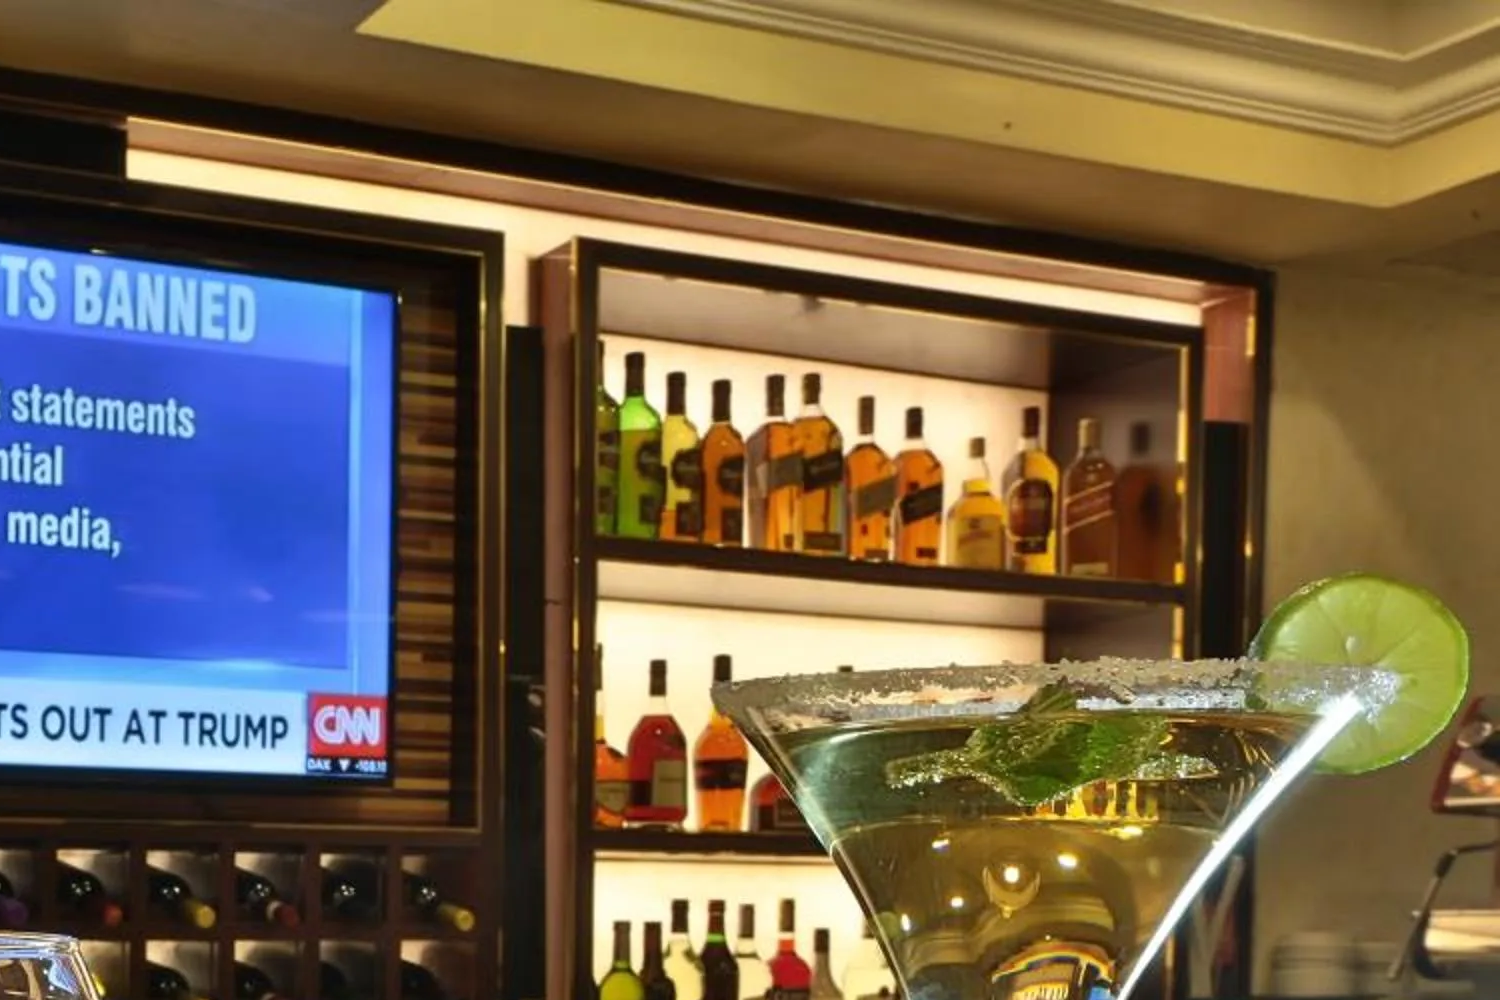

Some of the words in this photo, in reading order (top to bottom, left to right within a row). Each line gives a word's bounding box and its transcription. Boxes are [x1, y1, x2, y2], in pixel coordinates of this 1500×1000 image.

[73, 264, 256, 342] BANNED
[11, 384, 196, 438] statements
[8, 507, 121, 558] media,
[41, 704, 112, 743] OUT
[123, 708, 167, 744] AT
[178, 711, 288, 749] TRUMP
[314, 704, 381, 747] CNN
